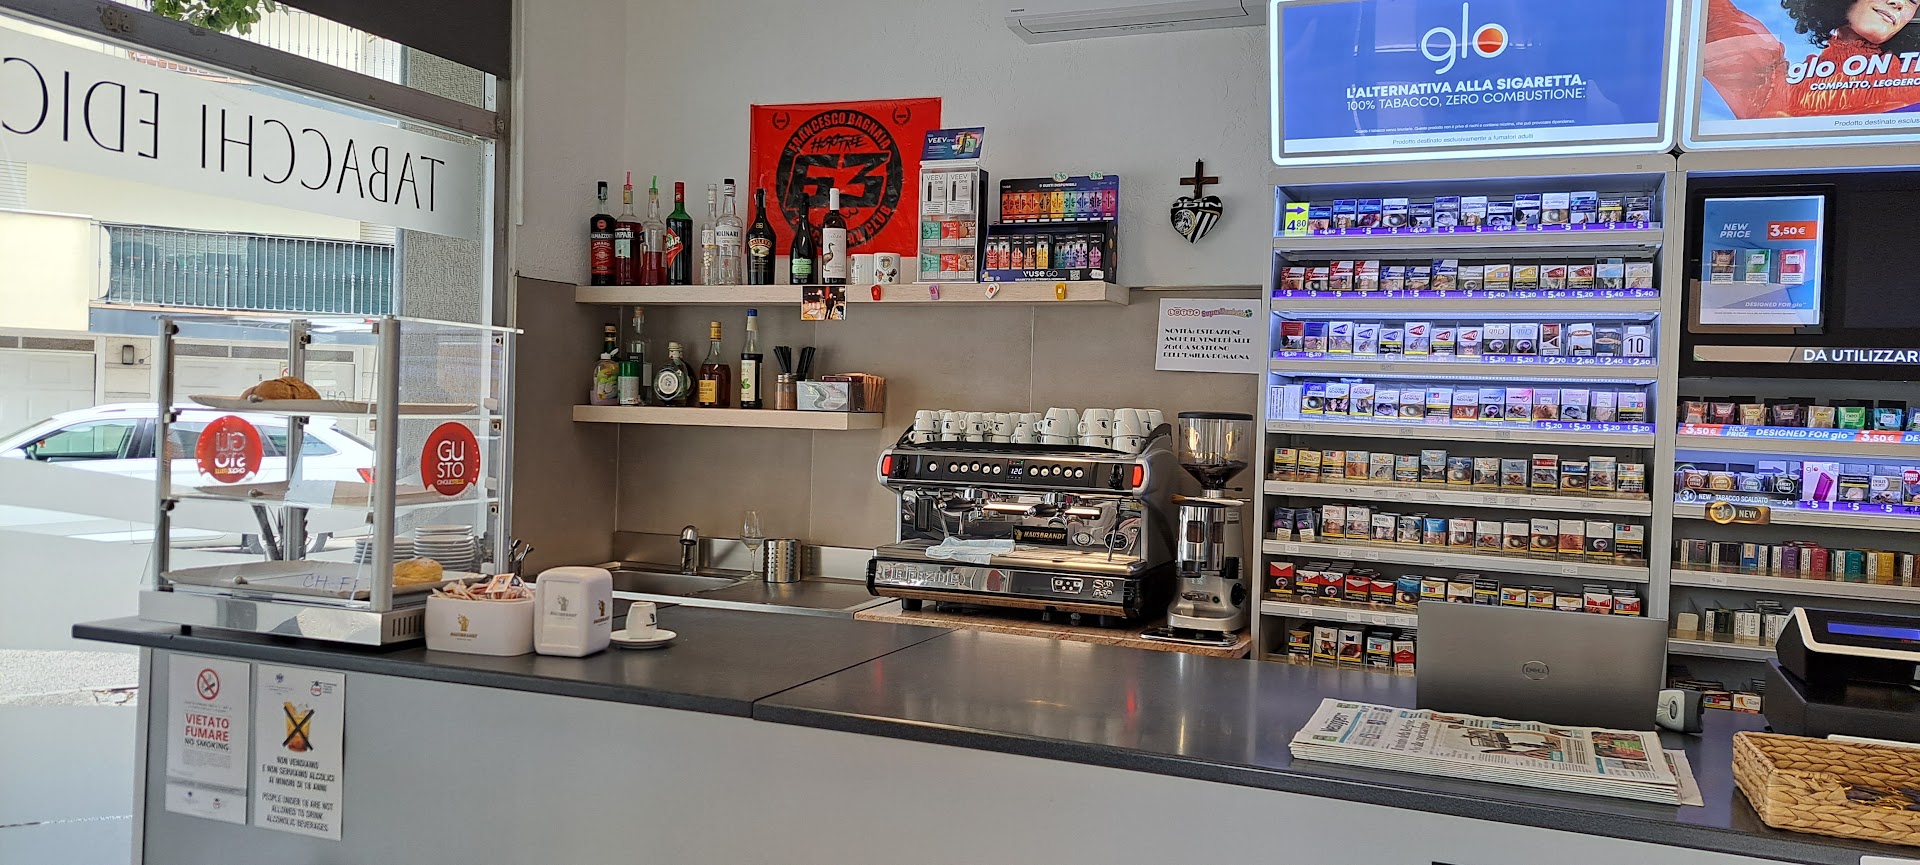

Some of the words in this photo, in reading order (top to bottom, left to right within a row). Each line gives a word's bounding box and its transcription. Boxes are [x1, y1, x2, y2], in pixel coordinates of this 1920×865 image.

[1421, 2, 1509, 75] glo
[1786, 57, 1836, 84] glo
[1842, 54, 1892, 76] ON
[1346, 82, 1450, 99] L'ALTERNATIVA
[1458, 79, 1493, 92] ALLA
[1496, 74, 1587, 90] SIGARETTA.
[1810, 81, 1871, 91] COMPATTO,
[1346, 100, 1376, 111] 100%
[1378, 95, 1442, 110] TABACCO,
[1446, 93, 1479, 106] ZERO
[788, 112, 846, 152] FRANCESCO
[848, 112, 892, 150] BAGNAIA
[864, 204, 892, 235] CLUB
[1720, 230, 1751, 238] PRICE
[1723, 223, 1749, 231] NEW
[1628, 338, 1644, 353] 10
[1804, 349, 1827, 361] DA
[1831, 350, 1920, 363] UTILIZZAR
[1756, 428, 1806, 438] DESIGNED
[1808, 431, 1829, 439] FOR
[437, 440, 464, 461] GU
[437, 462, 464, 478] STO
[1715, 494, 1740, 502] TABACCO
[1741, 496, 1768, 504] SCALDATO
[1739, 510, 1757, 518] NEW
[1024, 531, 1066, 540] HAUSBRANDT
[1525, 666, 1545, 674] DELL
[185, 713, 229, 729] VIETATO
[185, 726, 229, 742] FUMARE
[185, 738, 194, 746] NO
[196, 739, 229, 751] SMOKING
[289, 758, 319, 769] VENDIAMO
[279, 767, 308, 779] SERVIAMO
[262, 792, 282, 802] PEOPLE
[283, 794, 300, 805] UNDER
[272, 804, 296, 816] ALLOWED
[306, 809, 324, 819] DRINK
[266, 814, 296, 826] ALCOHOLIC
[297, 820, 328, 832] BEVERAGES
